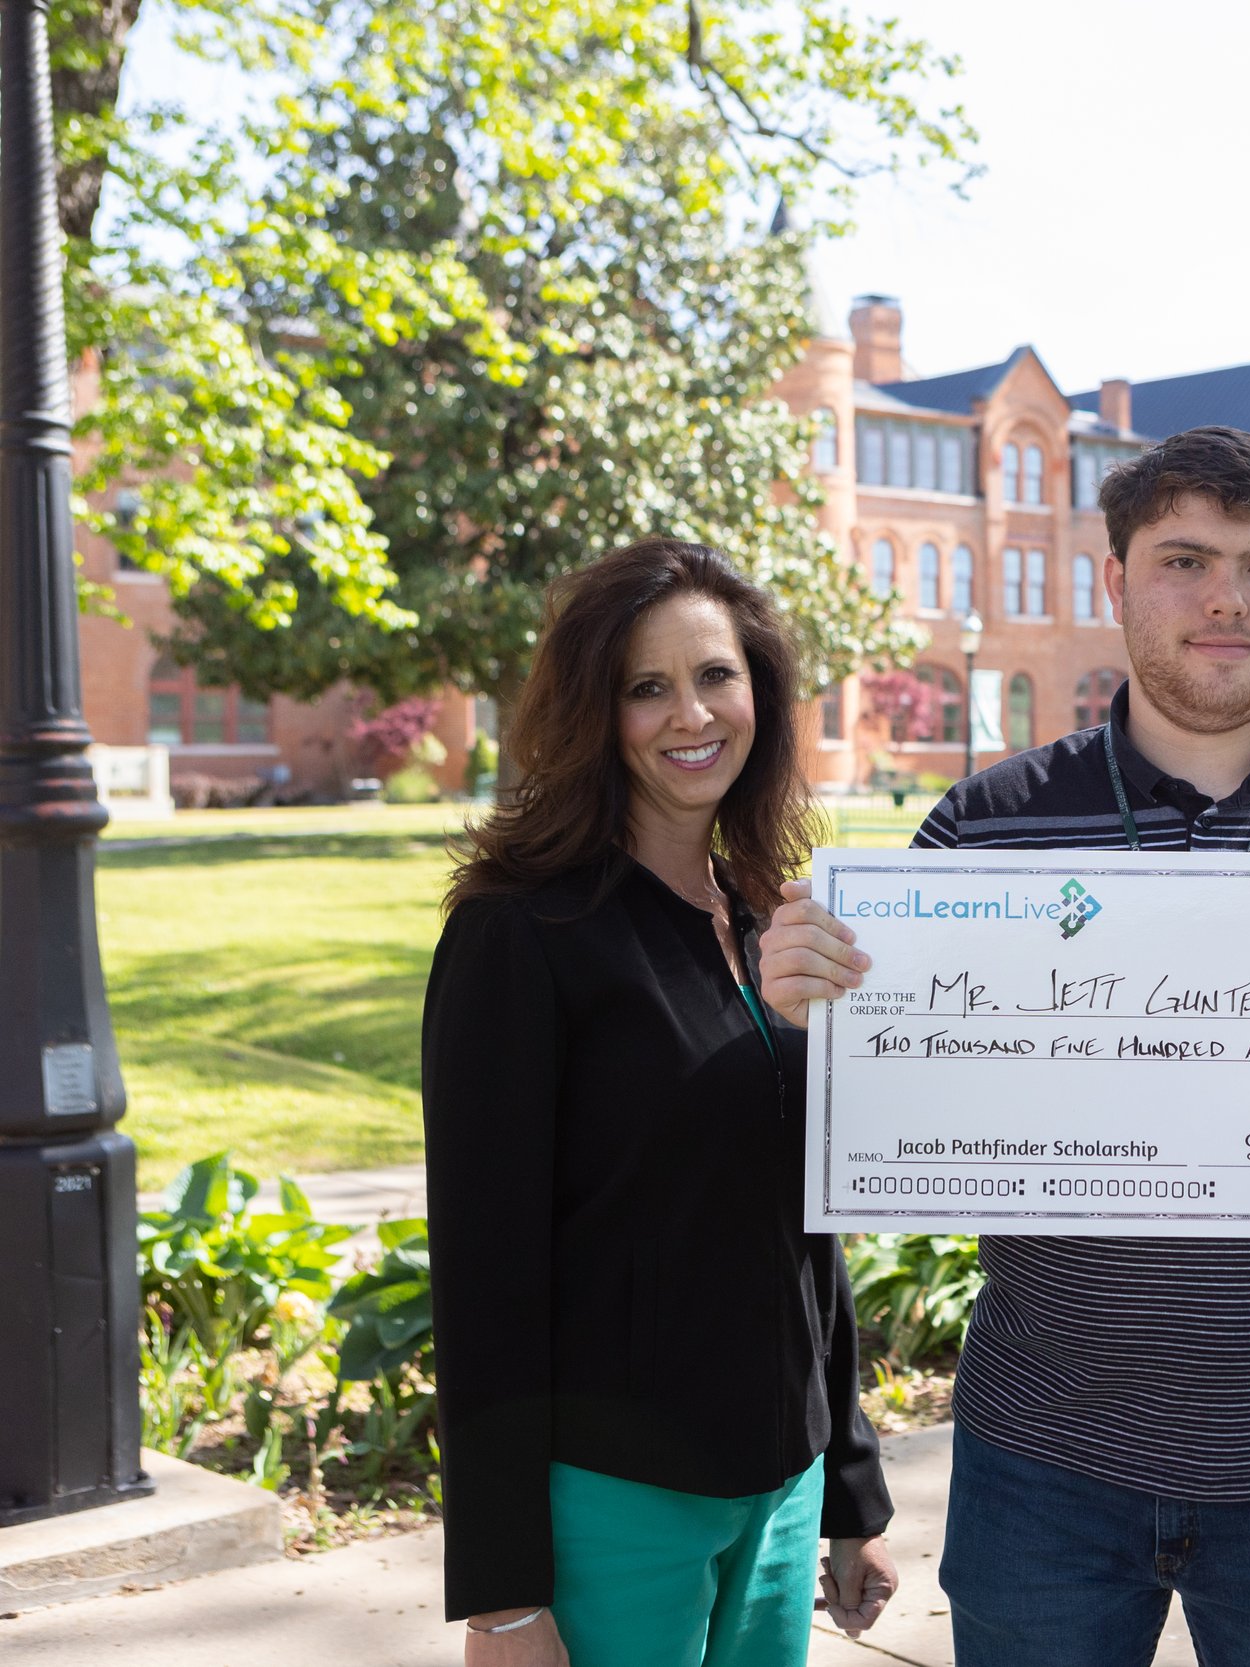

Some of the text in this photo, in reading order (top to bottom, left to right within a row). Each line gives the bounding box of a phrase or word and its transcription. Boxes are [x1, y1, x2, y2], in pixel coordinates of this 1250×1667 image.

[838, 888, 1062, 920] LeadLearnLive
[850, 991, 916, 1003] PAY TO THE
[1016, 968, 1126, 1012] JETT
[850, 1005, 905, 1016] ORDER OF
[919, 1029, 1036, 1058] THOUSAND
[1051, 1035, 1105, 1058] FIVE
[1117, 1035, 1225, 1060] HUNDRED
[847, 1138, 1158, 1163] MEMO Jacob Pathfinder Scholarship
